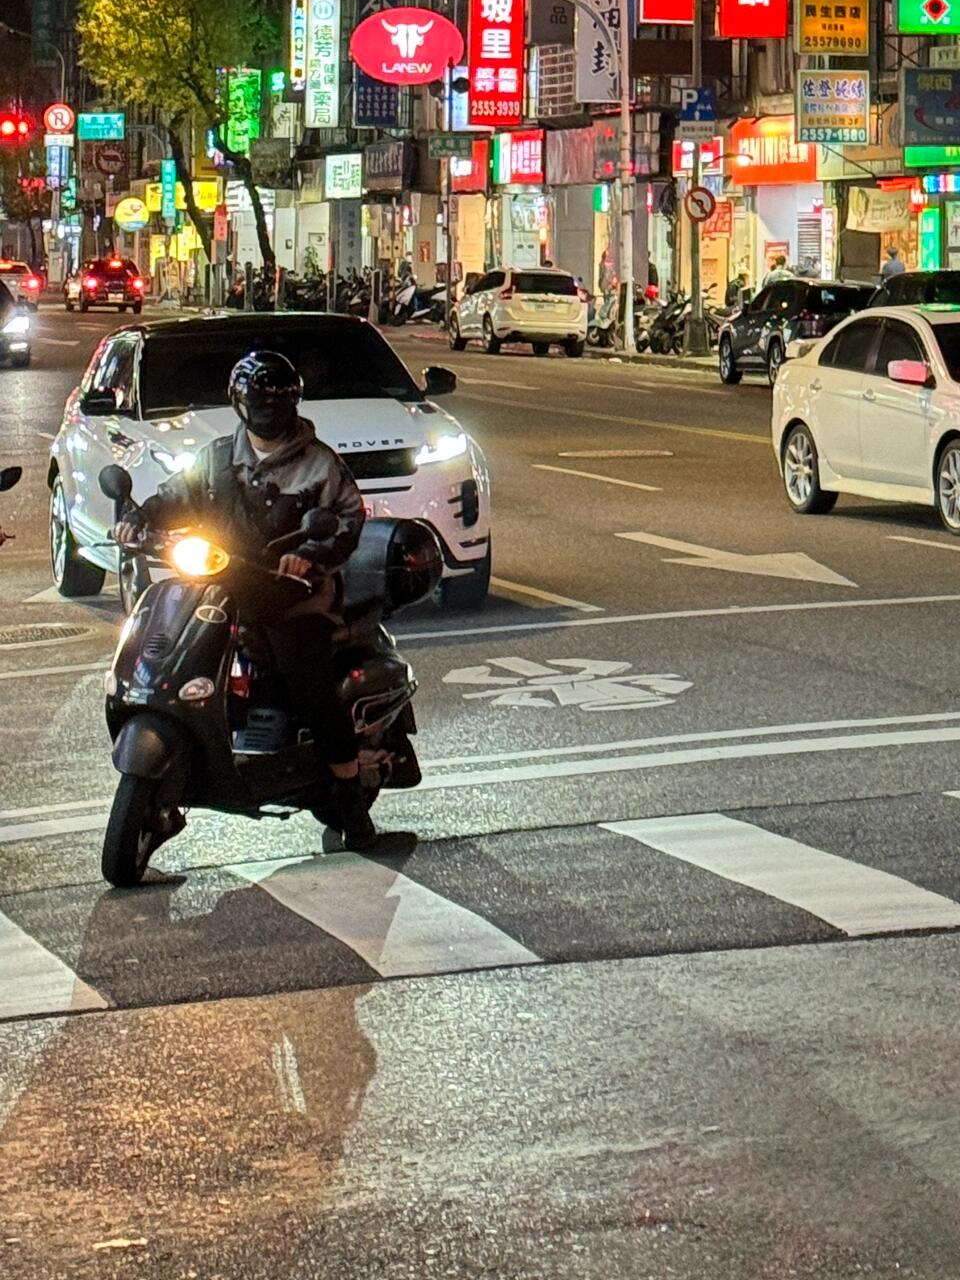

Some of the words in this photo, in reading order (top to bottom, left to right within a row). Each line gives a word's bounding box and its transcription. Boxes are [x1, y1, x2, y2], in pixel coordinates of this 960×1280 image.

[681, 90, 699, 111] P
[471, 100, 520, 117] 2553-3939
[801, 128, 866, 142] 2557-1580
[338, 438, 404, 448] ROVER
